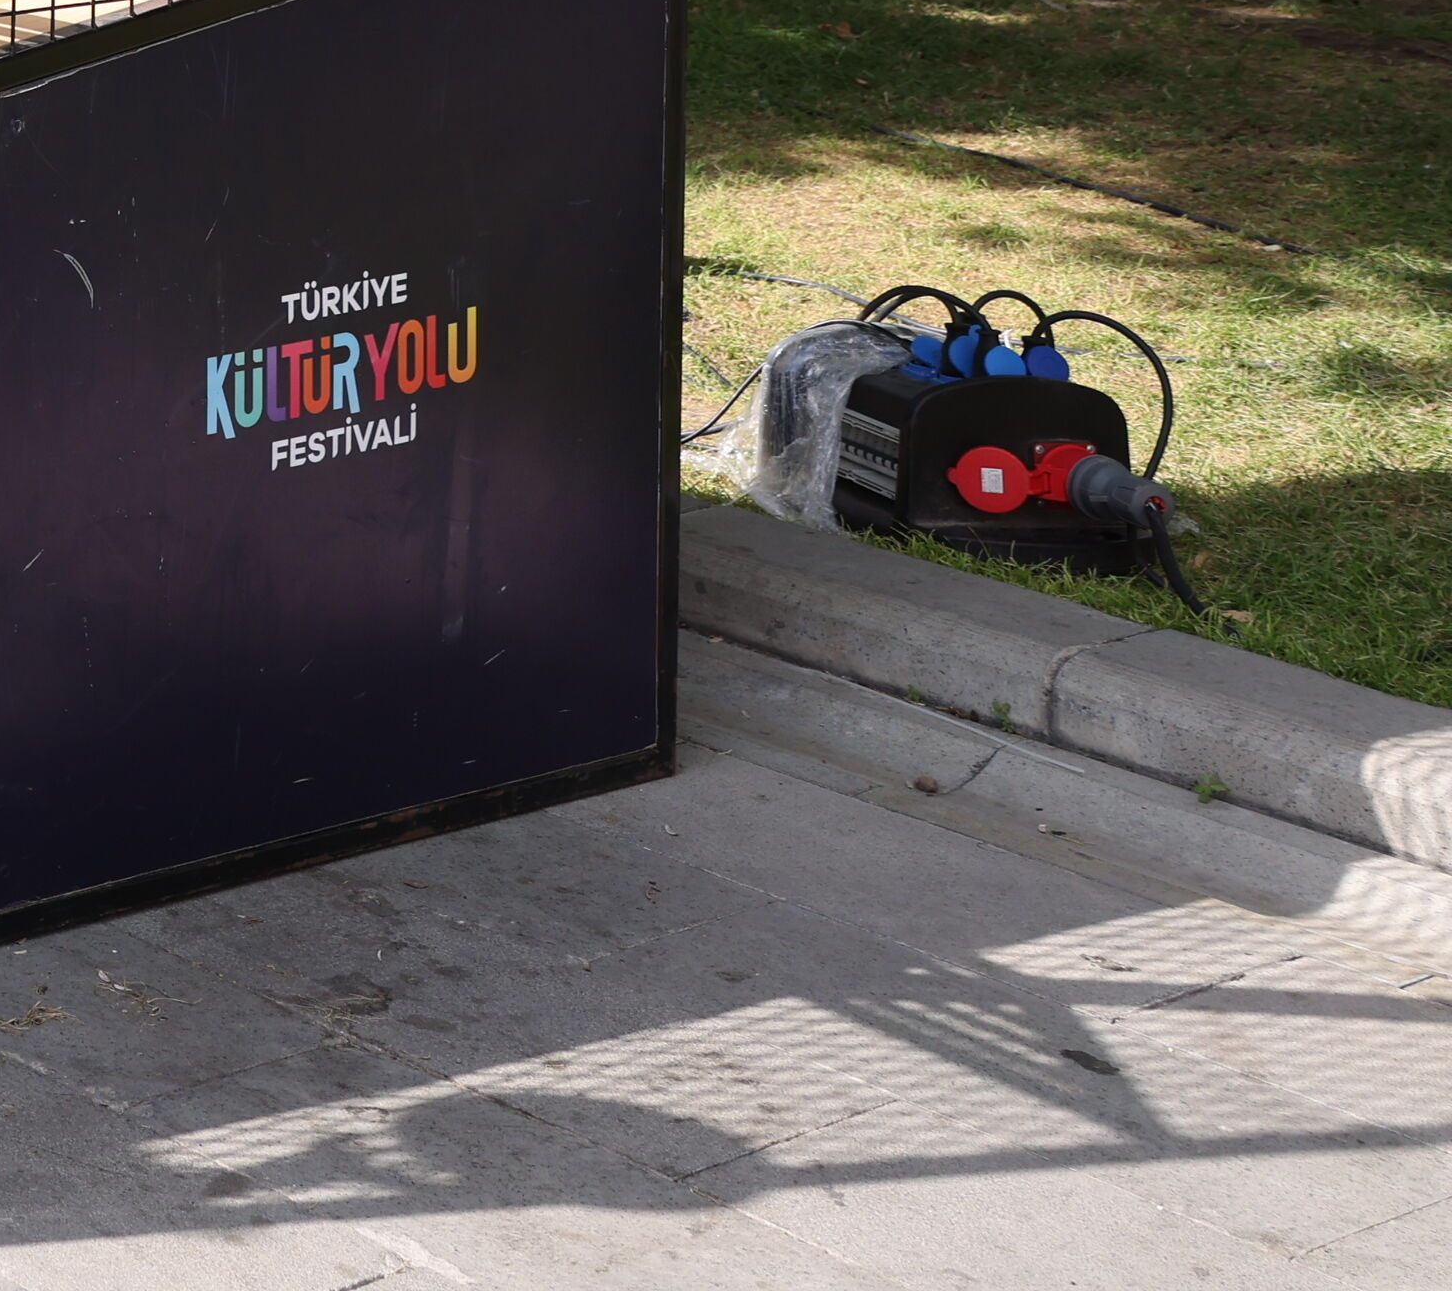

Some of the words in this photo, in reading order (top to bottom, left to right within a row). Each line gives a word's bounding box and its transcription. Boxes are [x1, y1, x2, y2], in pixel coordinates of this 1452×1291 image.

[281, 270, 408, 324] TÜRKİYE
[206, 331, 361, 440] KÜLTÜR
[364, 306, 477, 402] YOLU
[271, 403, 417, 471] FESTİVALİ
